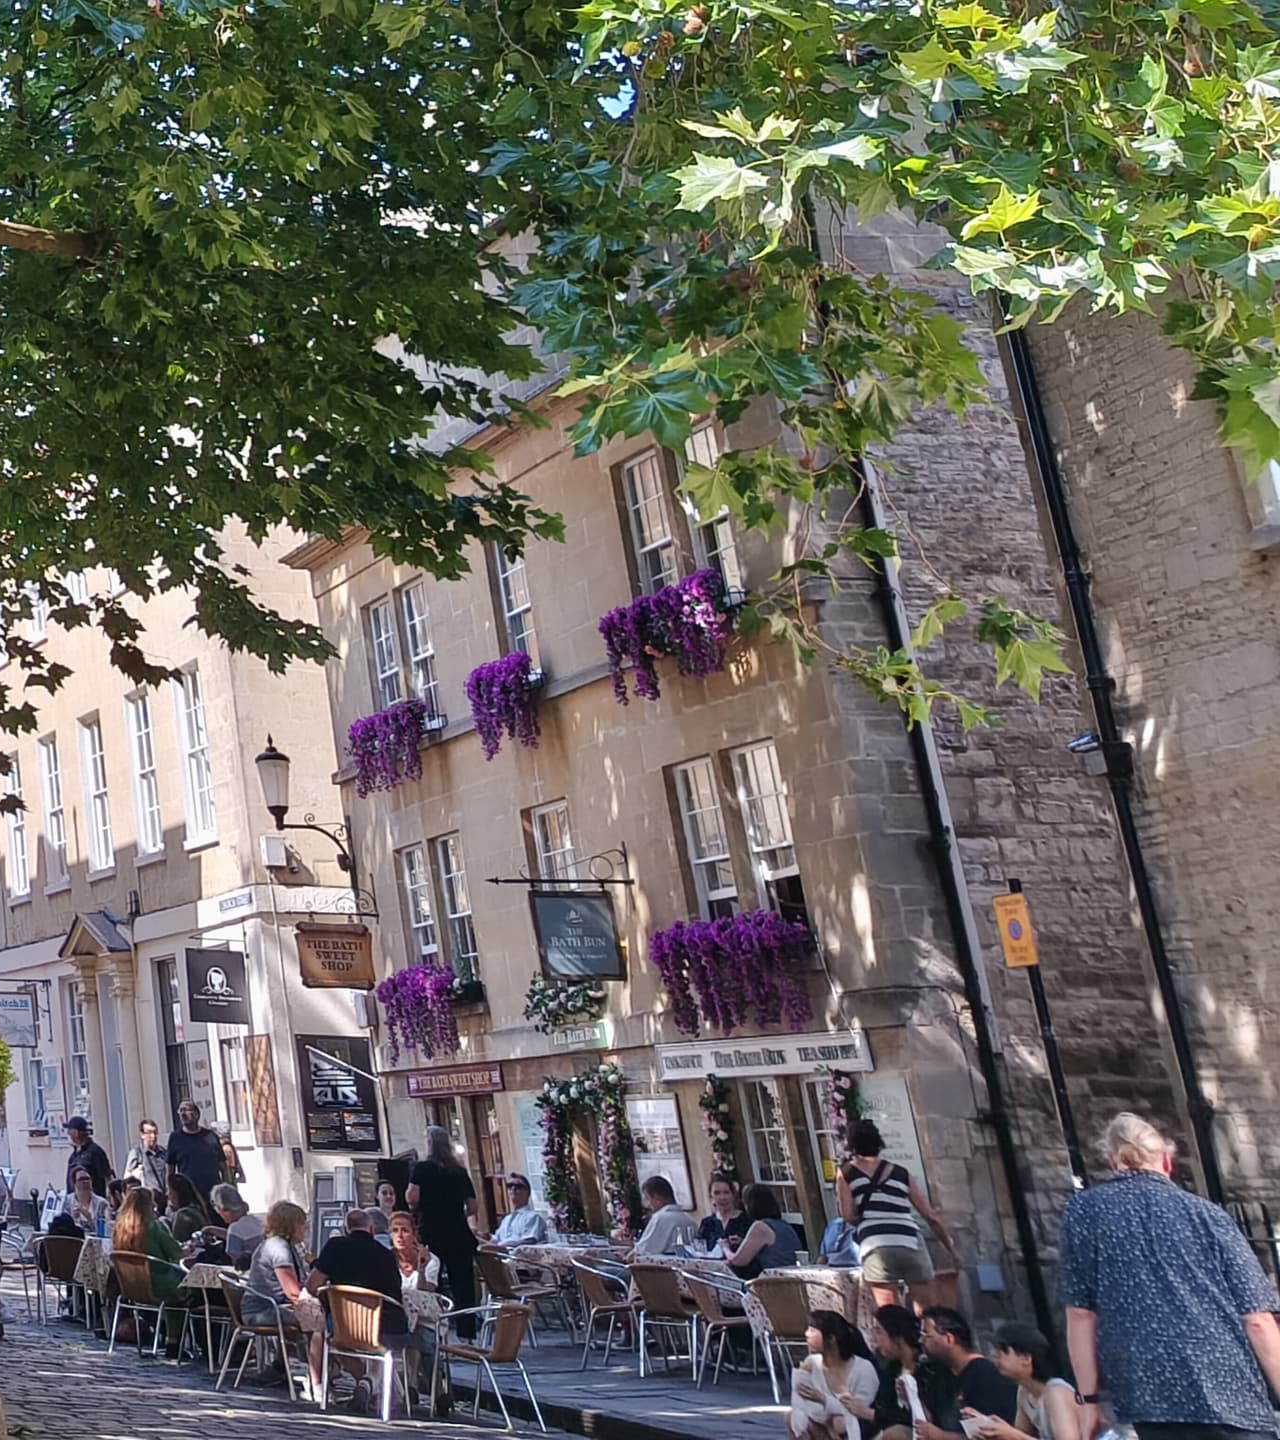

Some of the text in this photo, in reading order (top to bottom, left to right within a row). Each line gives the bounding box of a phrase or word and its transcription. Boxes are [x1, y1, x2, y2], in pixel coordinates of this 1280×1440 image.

[306, 940, 362, 951] THE BATH
[316, 951, 356, 961] SWEET
[321, 961, 352, 971] SHOP
